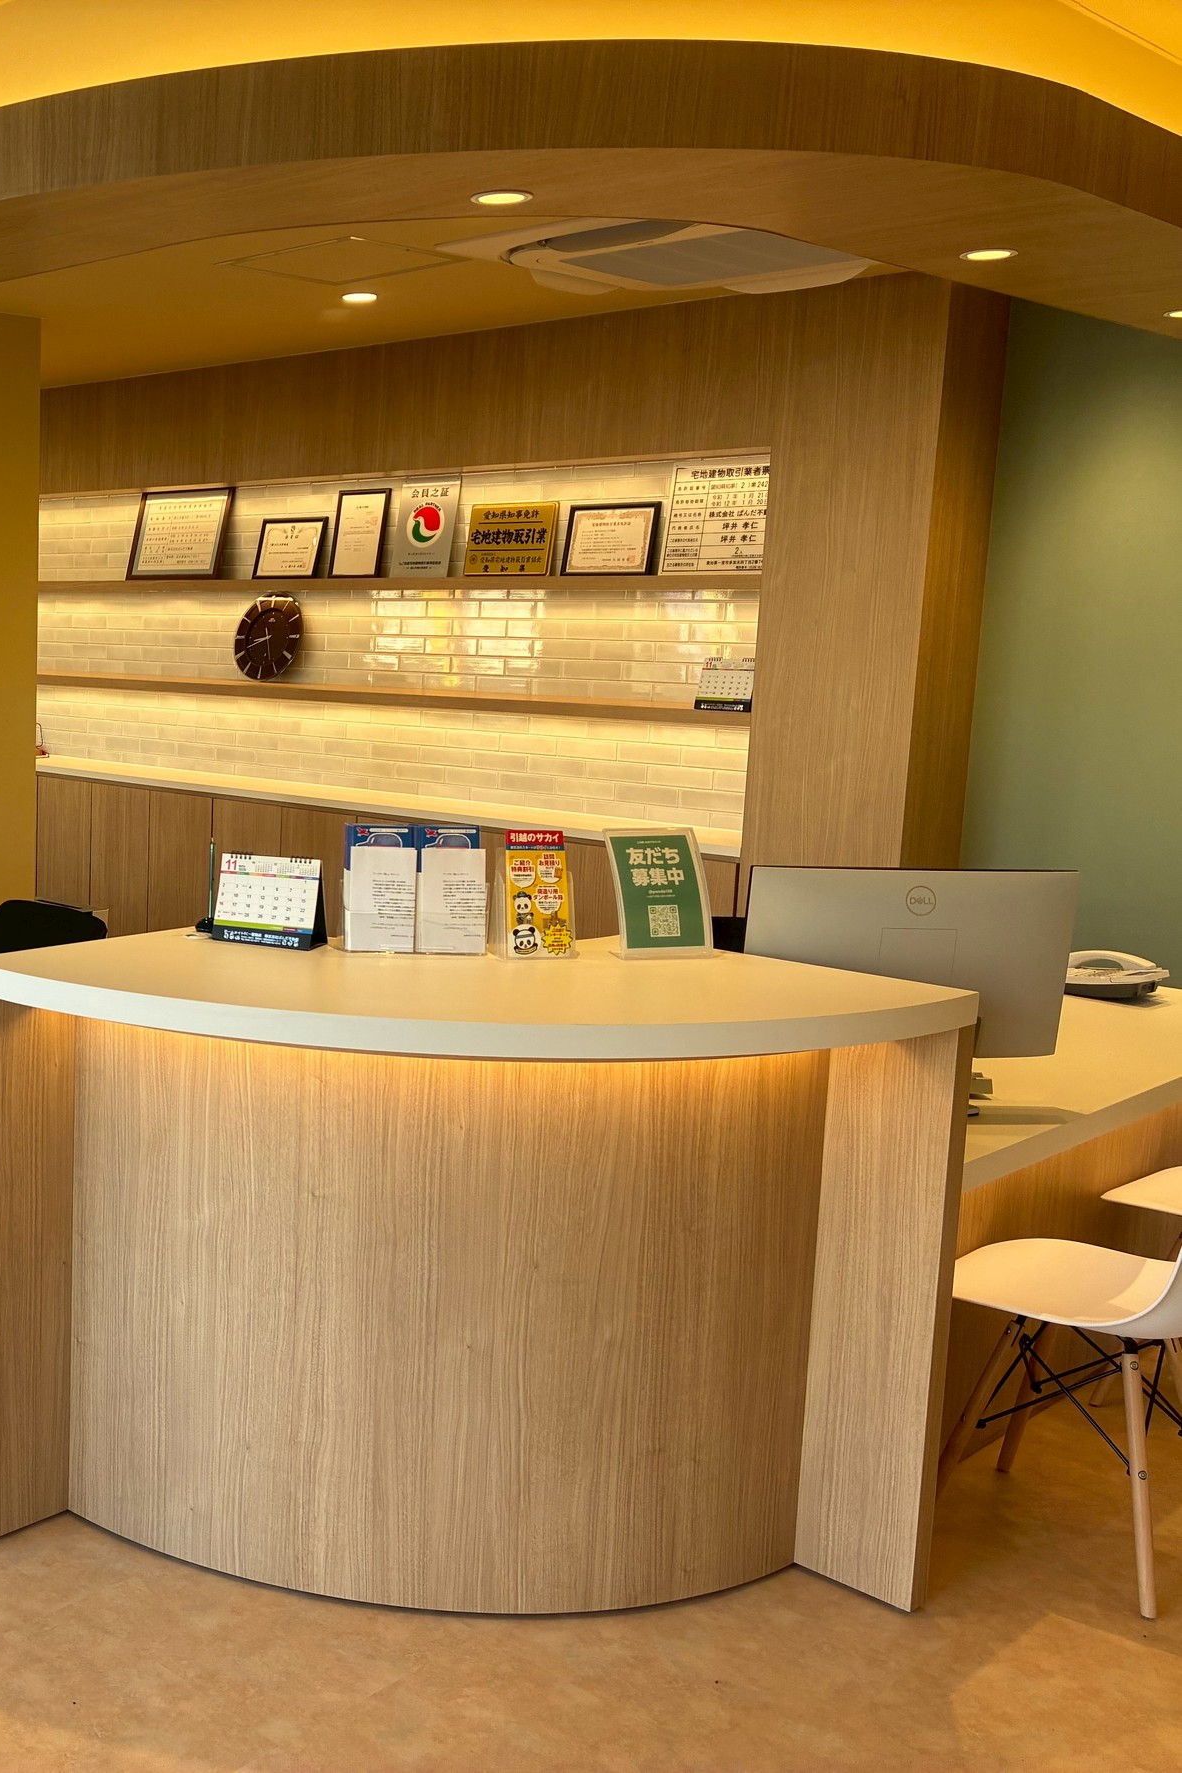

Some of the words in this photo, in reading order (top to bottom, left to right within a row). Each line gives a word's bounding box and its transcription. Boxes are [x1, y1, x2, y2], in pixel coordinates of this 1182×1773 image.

[411, 487, 449, 498] 会員之証
[483, 510, 539, 520] 愛知県知事免許
[709, 510, 735, 518] 株式会社
[471, 528, 547, 545] 宅地建物取引業
[510, 833, 559, 842] 引越のサカイ
[626, 847, 680, 865] 友だち
[226, 859, 237, 871] 11
[630, 867, 685, 886] 募集中
[910, 897, 933, 905] DELL
